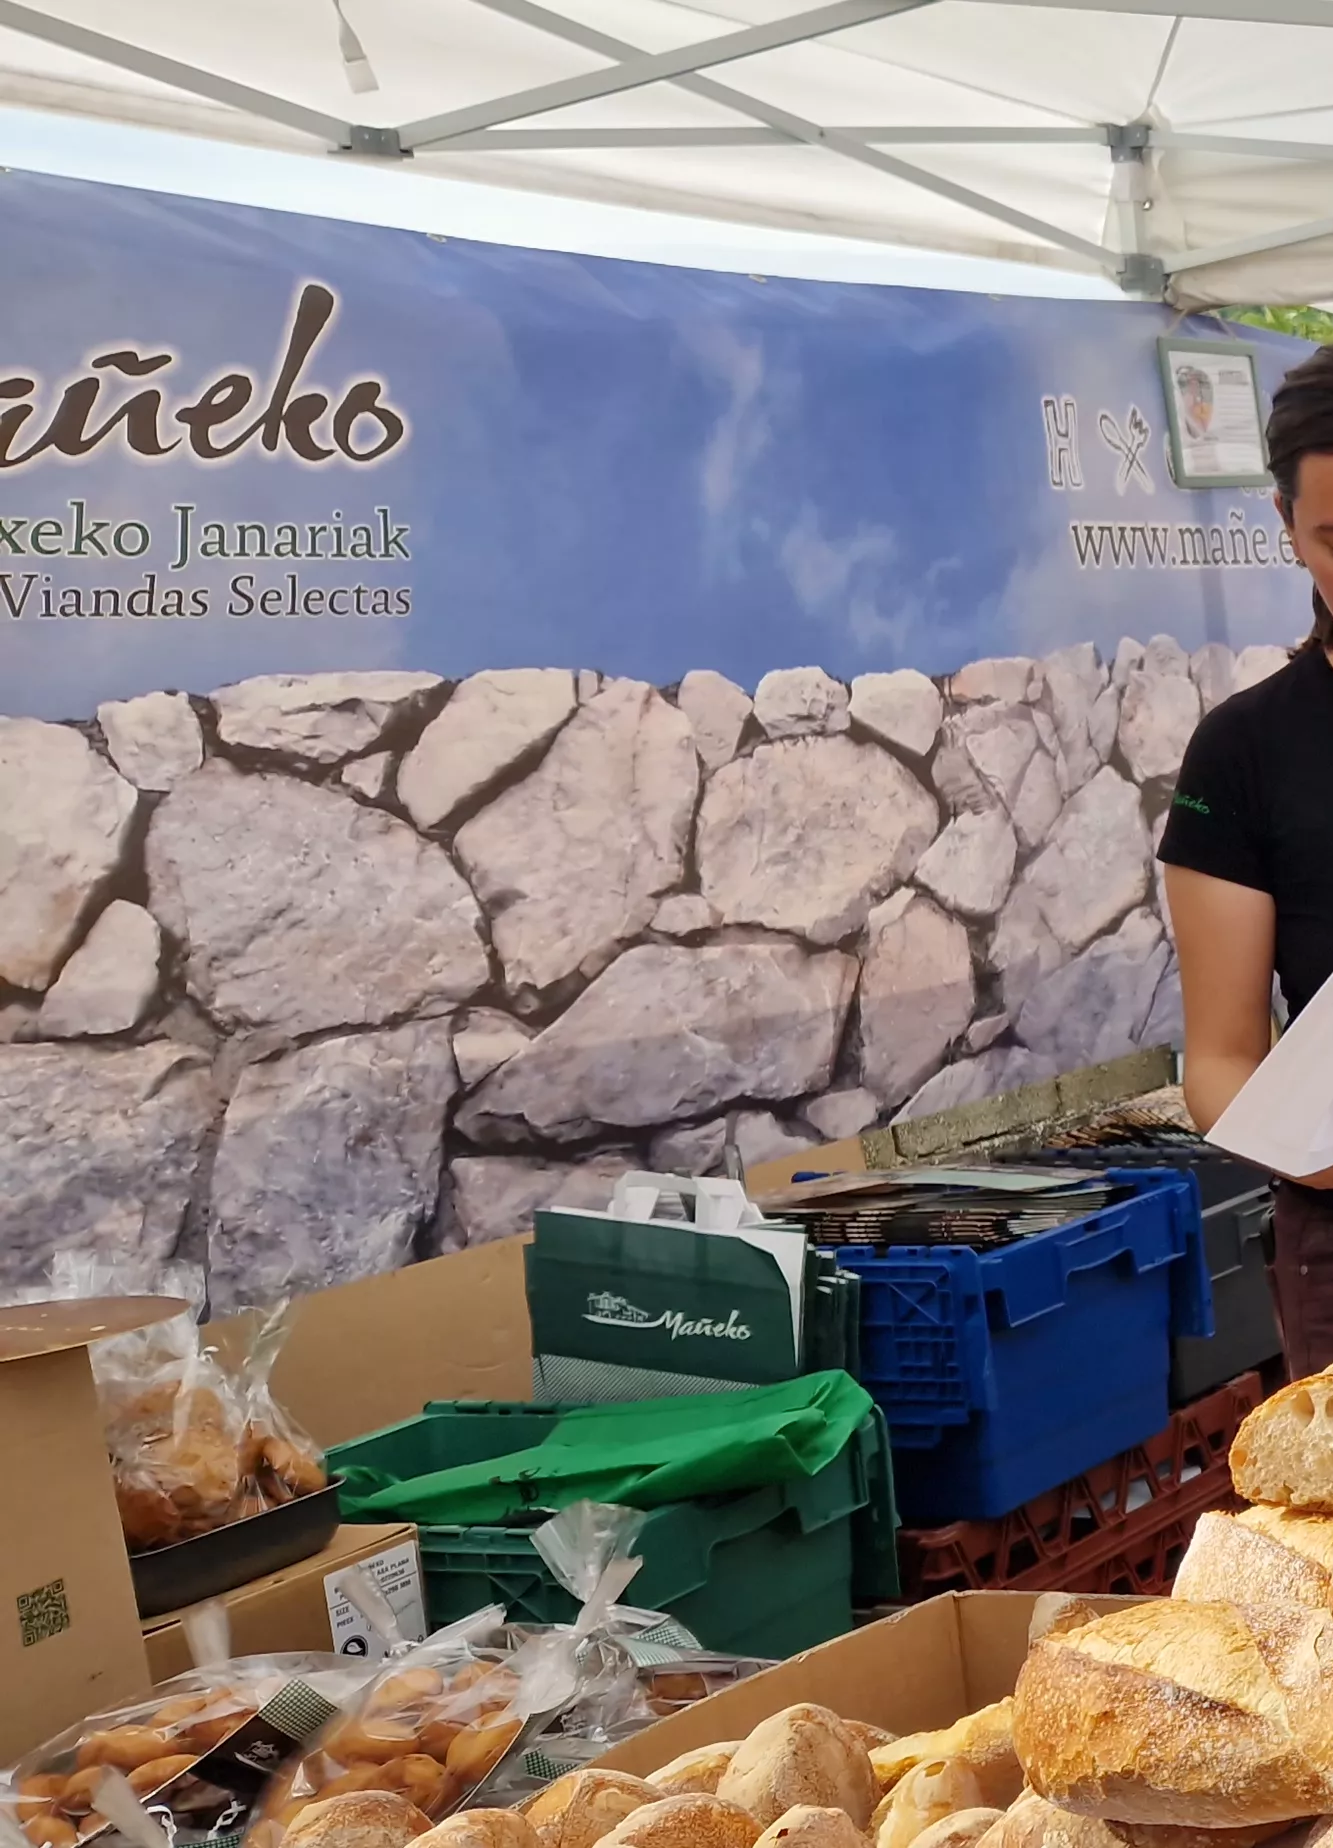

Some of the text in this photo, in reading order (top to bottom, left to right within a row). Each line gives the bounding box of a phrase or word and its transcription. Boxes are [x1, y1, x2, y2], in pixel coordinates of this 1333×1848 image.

[0, 284, 404, 467] añeko
[0, 501, 410, 570] xeko Janariak
[1071, 510, 1293, 566] www.mañe.e
[0, 573, 411, 618] Viandas Selectas
[655, 1309, 752, 1341] Mañeko
